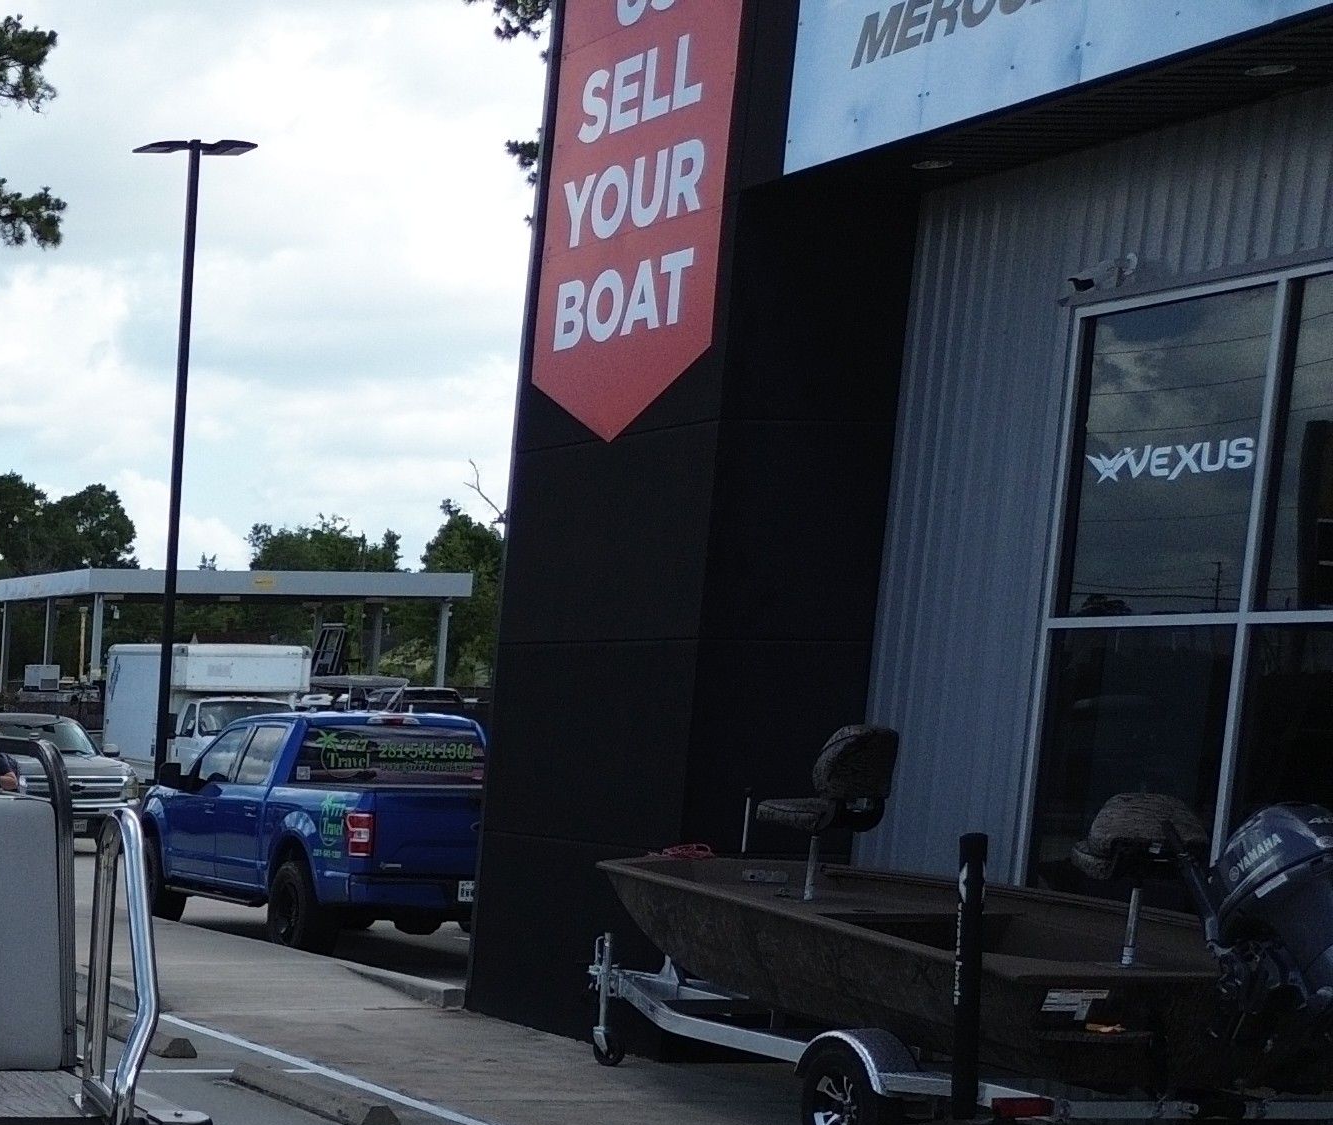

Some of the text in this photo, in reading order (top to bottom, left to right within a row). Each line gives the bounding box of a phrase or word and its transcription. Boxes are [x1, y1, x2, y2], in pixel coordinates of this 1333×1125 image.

[578, 34, 702, 143] SELL
[564, 139, 705, 248] YOUR
[553, 247, 694, 352] BOAT
[1125, 437, 1254, 480] VEXUS
[326, 751, 370, 769] Travel
[1237, 833, 1282, 872] YAMAHA
